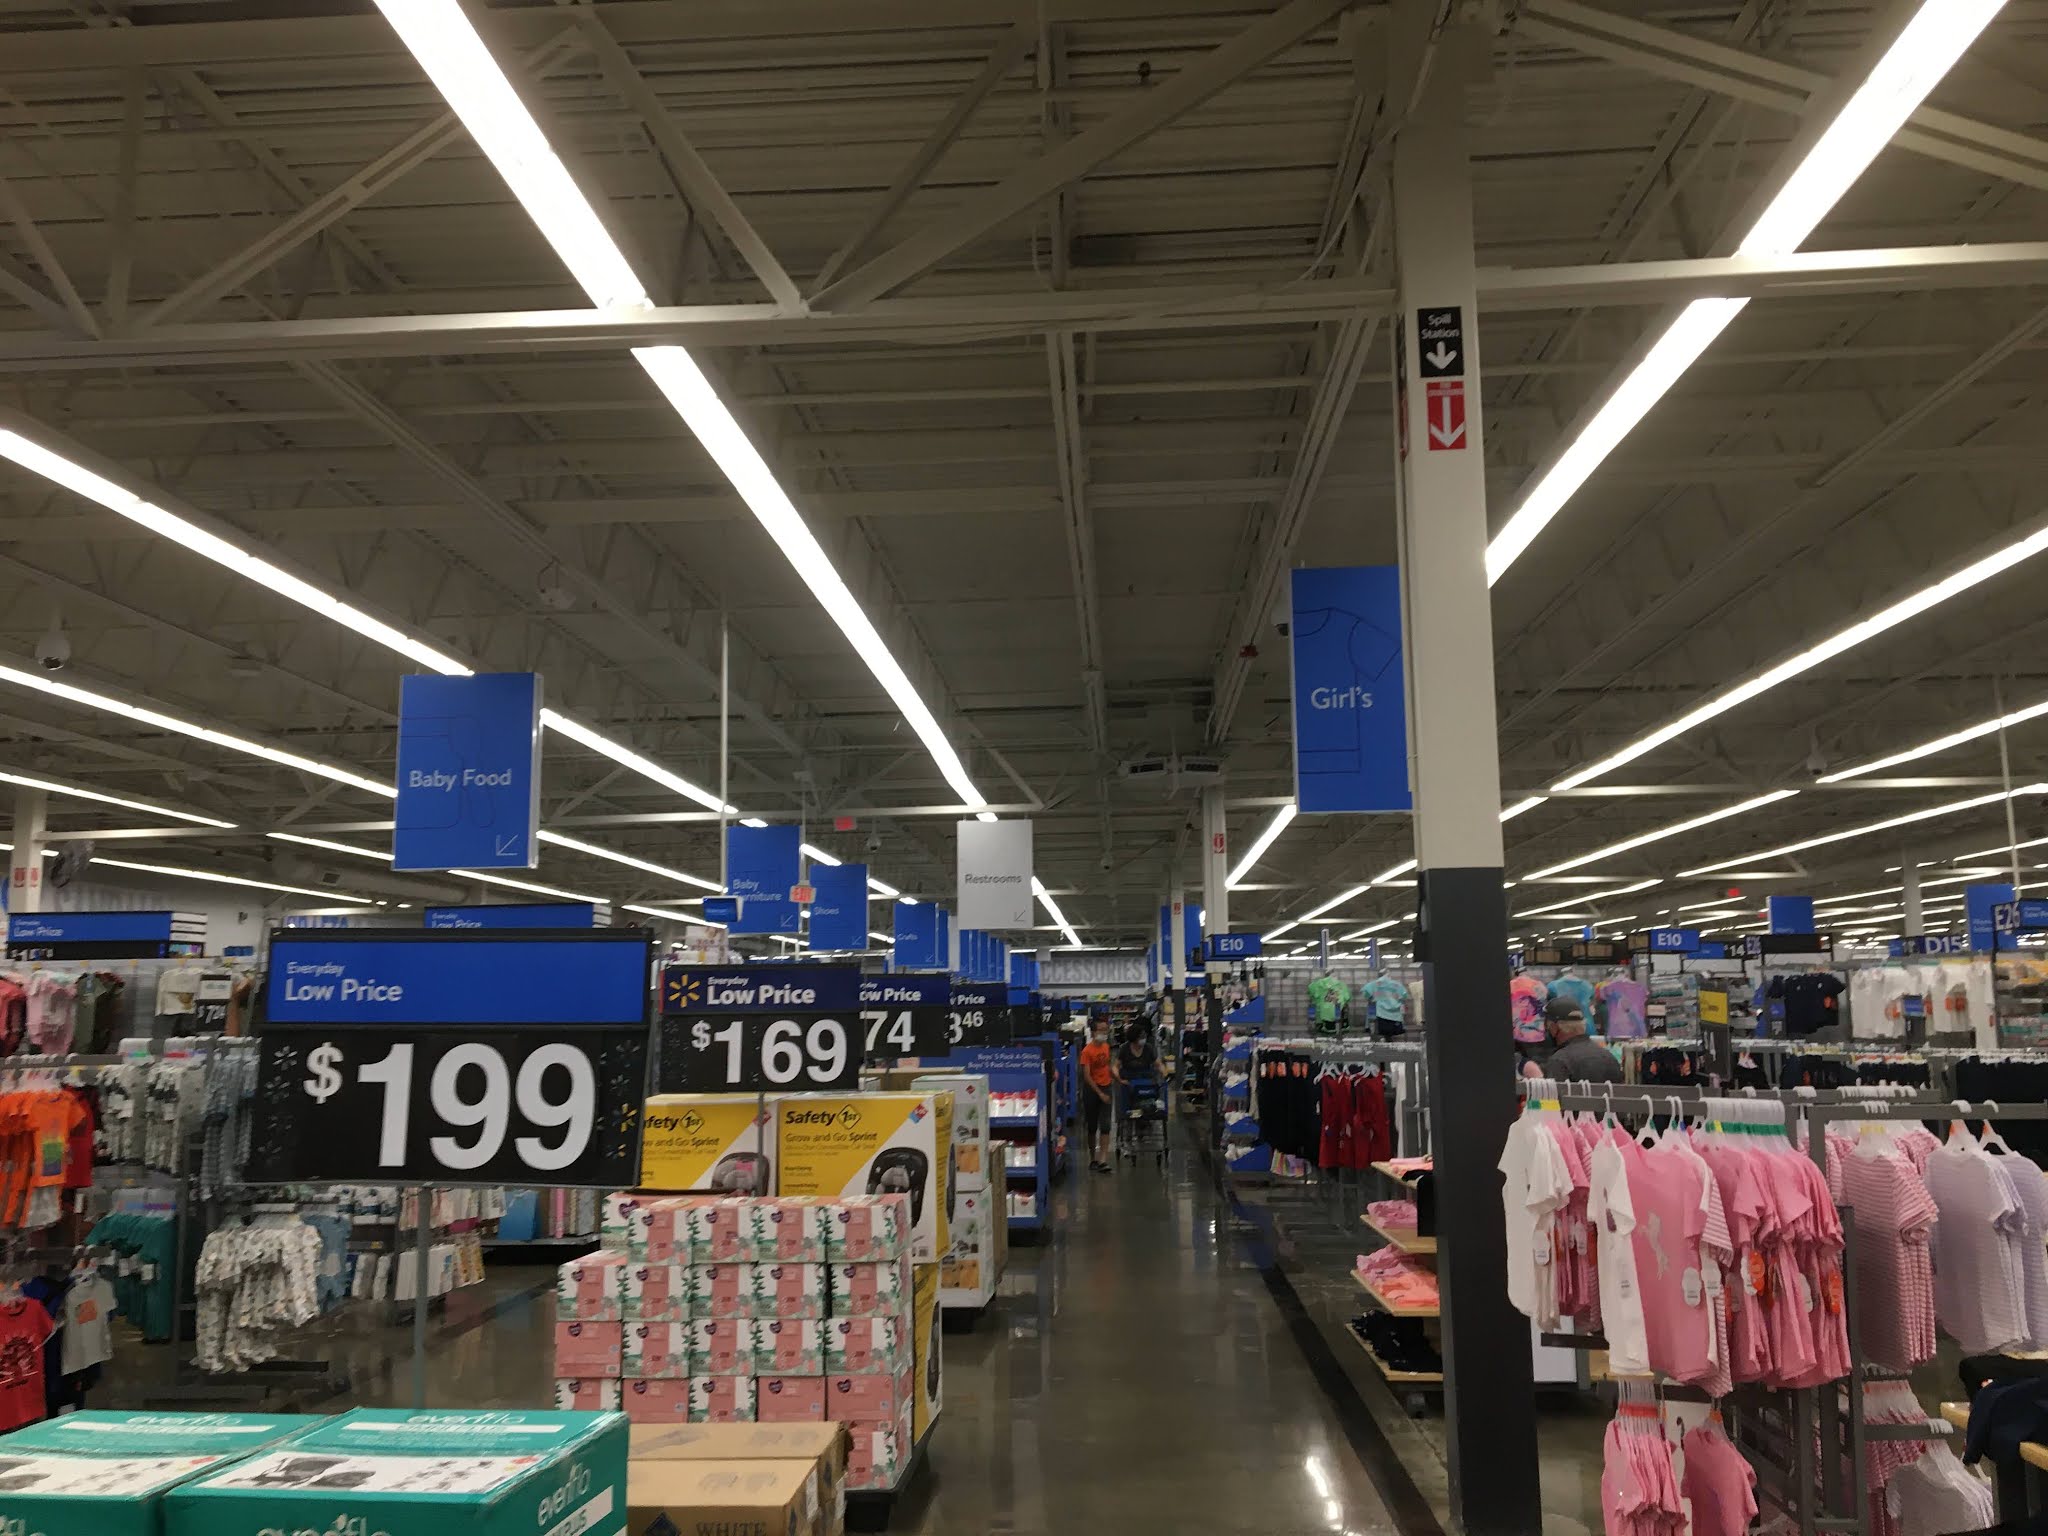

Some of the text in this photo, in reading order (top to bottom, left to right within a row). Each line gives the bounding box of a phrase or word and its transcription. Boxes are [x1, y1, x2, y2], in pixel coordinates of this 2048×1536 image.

[1427, 313, 1452, 327] Spill
[1421, 327, 1460, 340] Station
[1310, 686, 1374, 709] Girl's
[409, 768, 512, 792] Baby Food
[732, 878, 760, 892] Baby
[964, 873, 1022, 885] Restrooms
[1220, 938, 1245, 952] E10
[1657, 933, 1683, 947] E10
[1924, 936, 1962, 954] D15
[287, 961, 346, 978] Everyday
[1041, 957, 1144, 983] CCESSORIES
[707, 975, 750, 987] Everyday
[285, 978, 403, 1002] Low Price
[706, 983, 817, 1006] Low Price
[859, 987, 923, 1002] ow Price
[957, 993, 987, 1006] Price
[643, 1115, 680, 1132] fety
[785, 1110, 837, 1127] Safety
[656, 1137, 673, 1147] and
[674, 1137, 690, 1147] Go
[690, 1136, 720, 1149] Sprint
[785, 1131, 878, 1144] Grow and Go Sprint
[406, 1411, 527, 1425] evenflo
[537, 1462, 592, 1528] evenflo
[696, 1520, 768, 1536] WHITE
